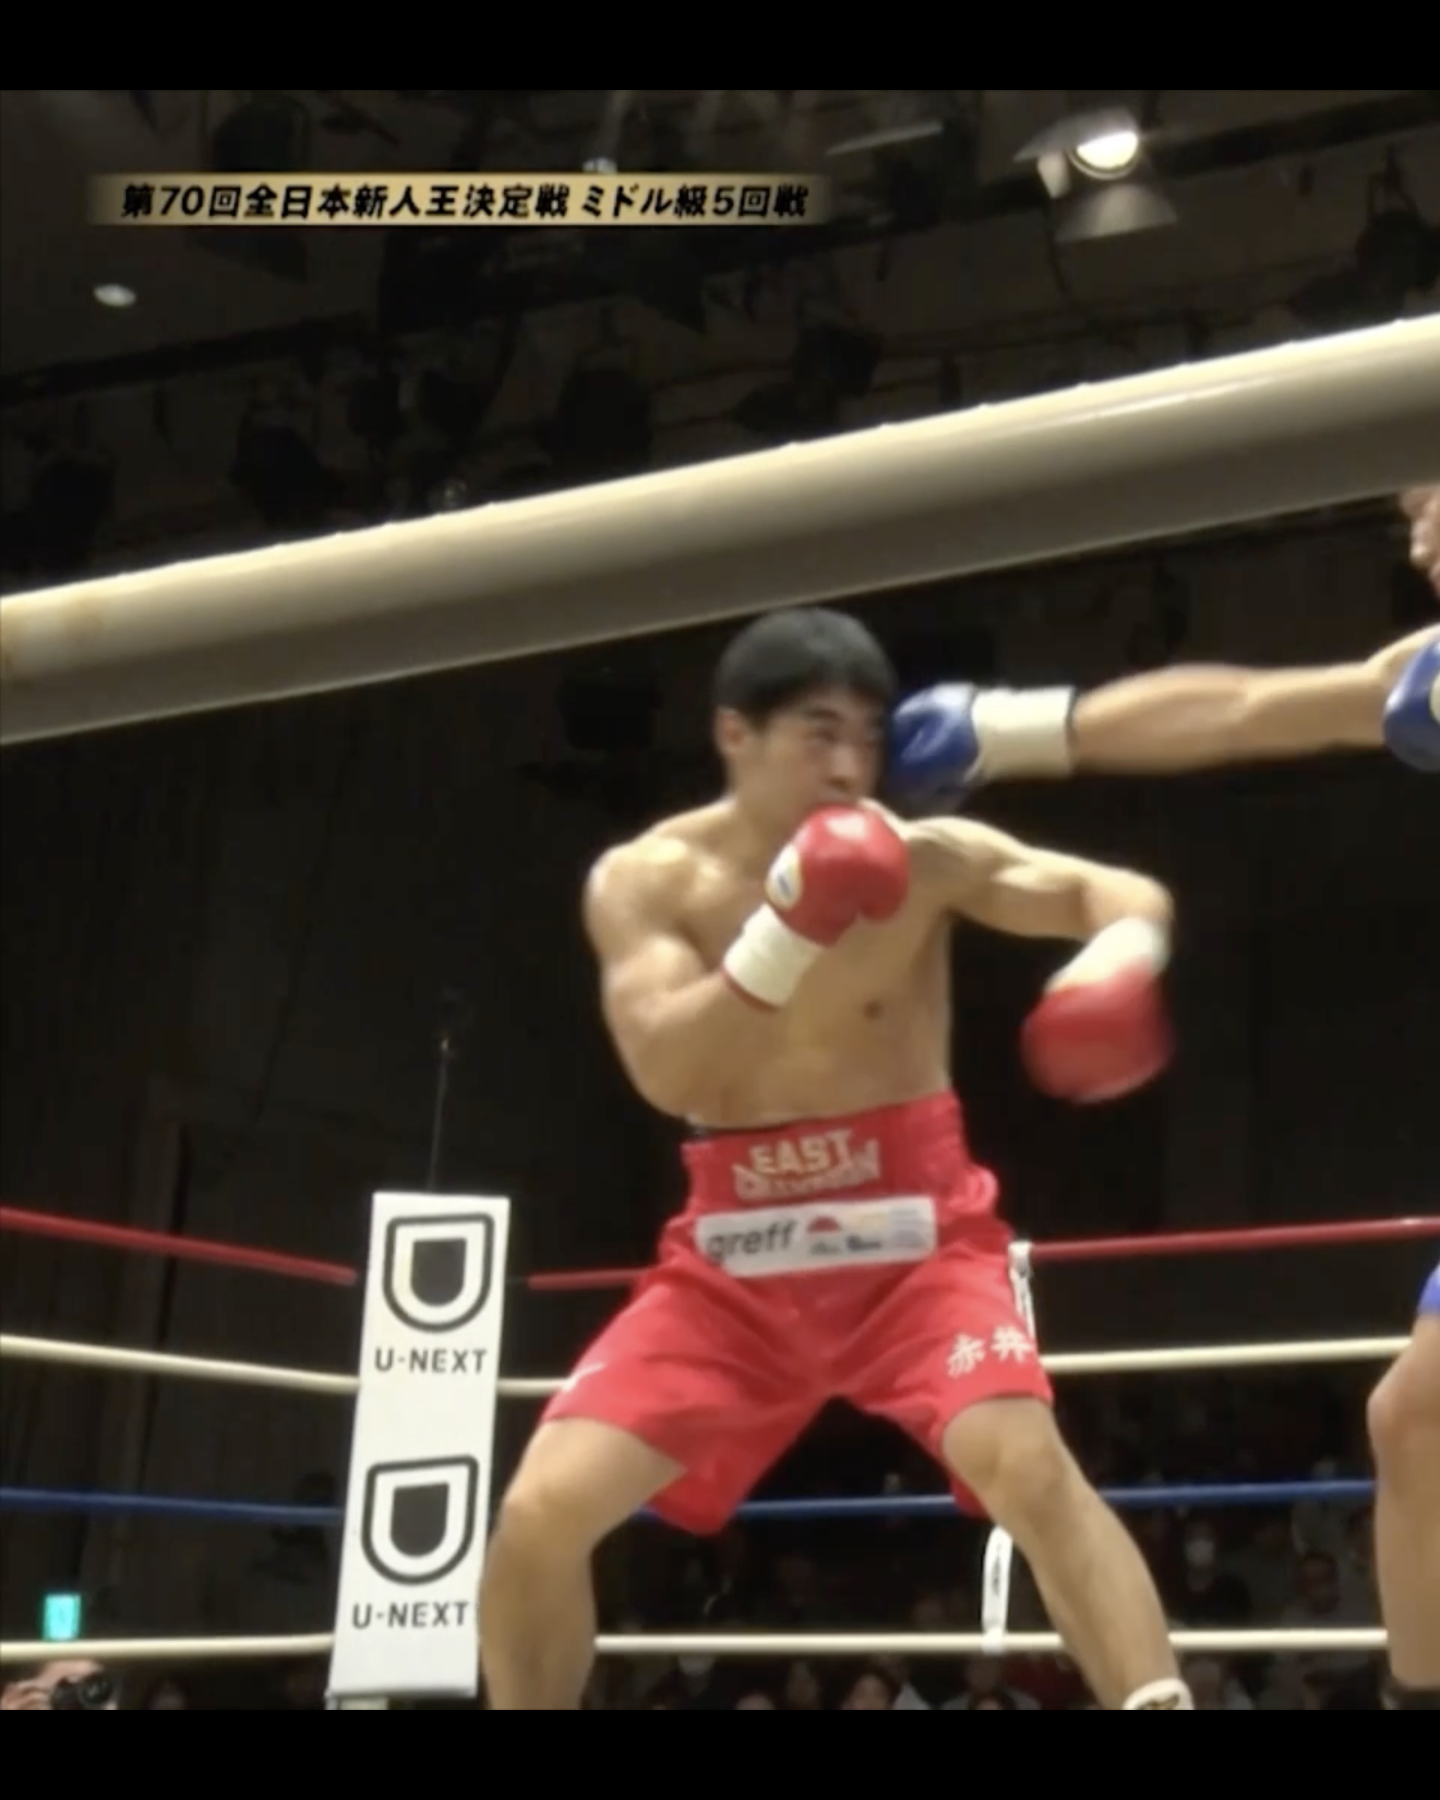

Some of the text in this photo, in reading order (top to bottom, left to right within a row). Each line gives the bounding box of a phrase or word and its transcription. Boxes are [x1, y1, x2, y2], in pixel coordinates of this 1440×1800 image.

[748, 1128, 854, 1175] EAST
[374, 1347, 488, 1374] U-NEXT
[352, 1602, 469, 1630] U-NEXT
